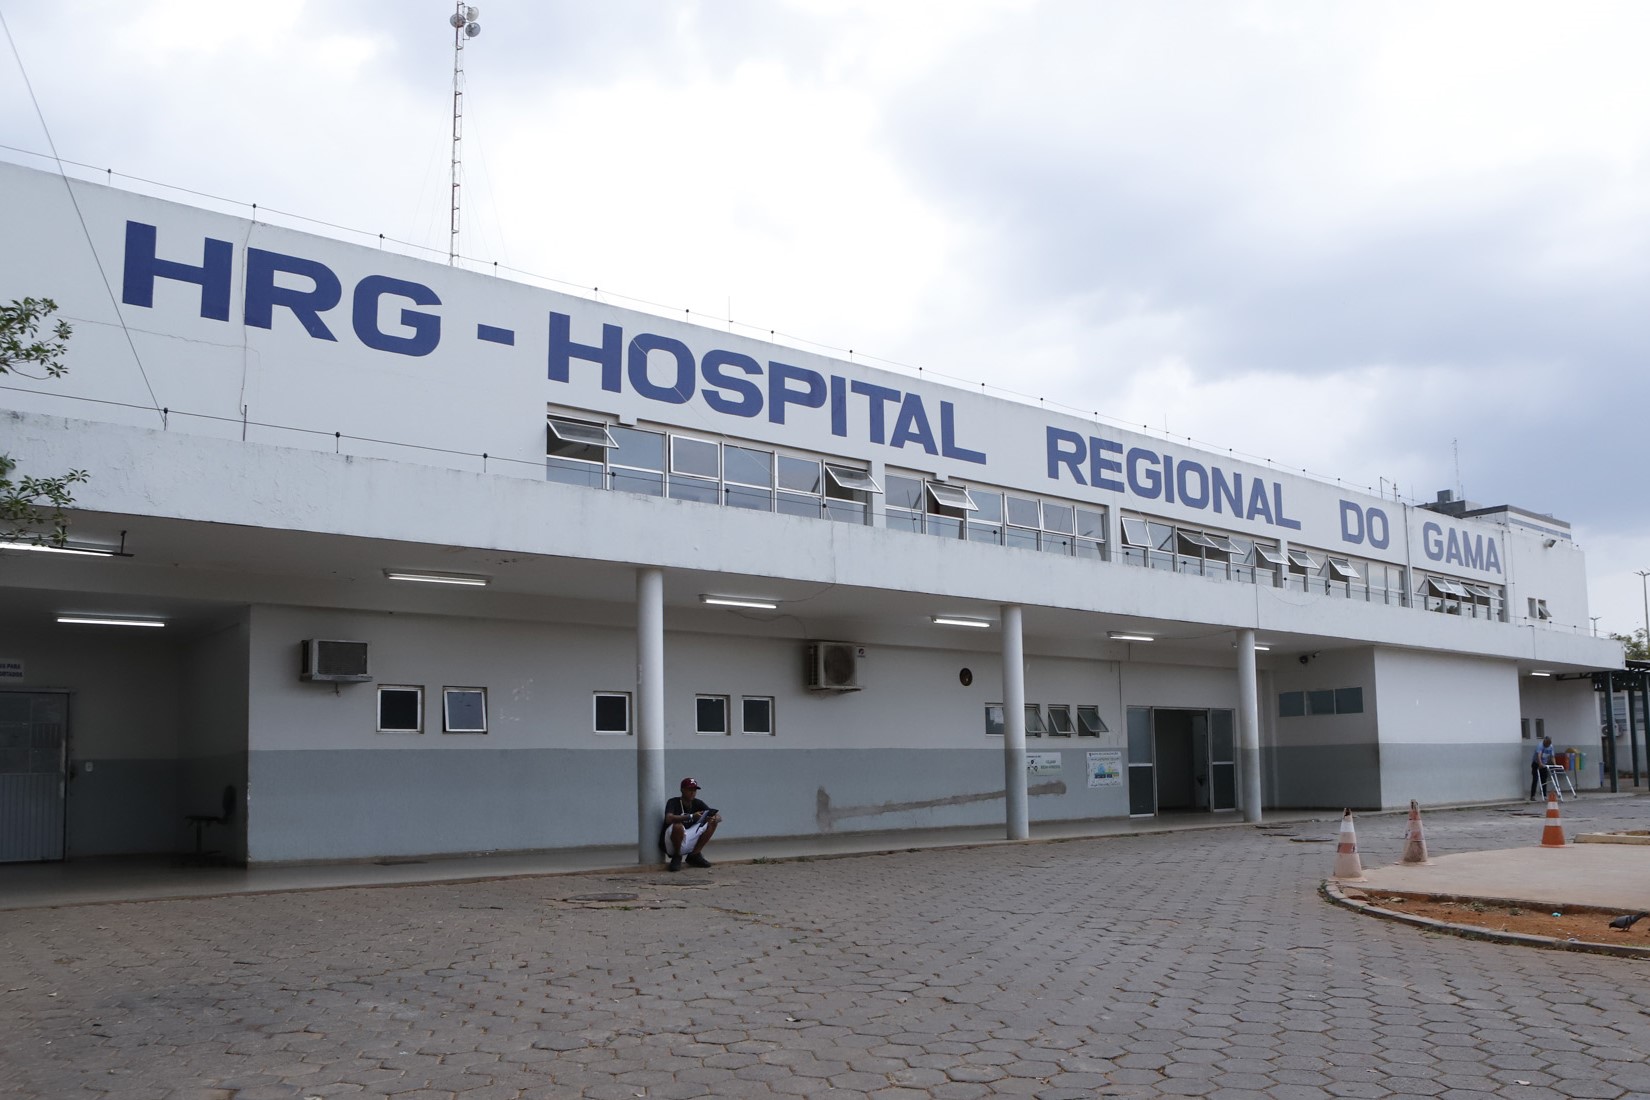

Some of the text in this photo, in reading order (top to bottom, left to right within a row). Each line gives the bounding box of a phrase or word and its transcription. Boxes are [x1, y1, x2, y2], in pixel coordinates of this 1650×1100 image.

[122, 220, 1502, 574] HRG - HOSPITAL REGIONAL DO GAMA
